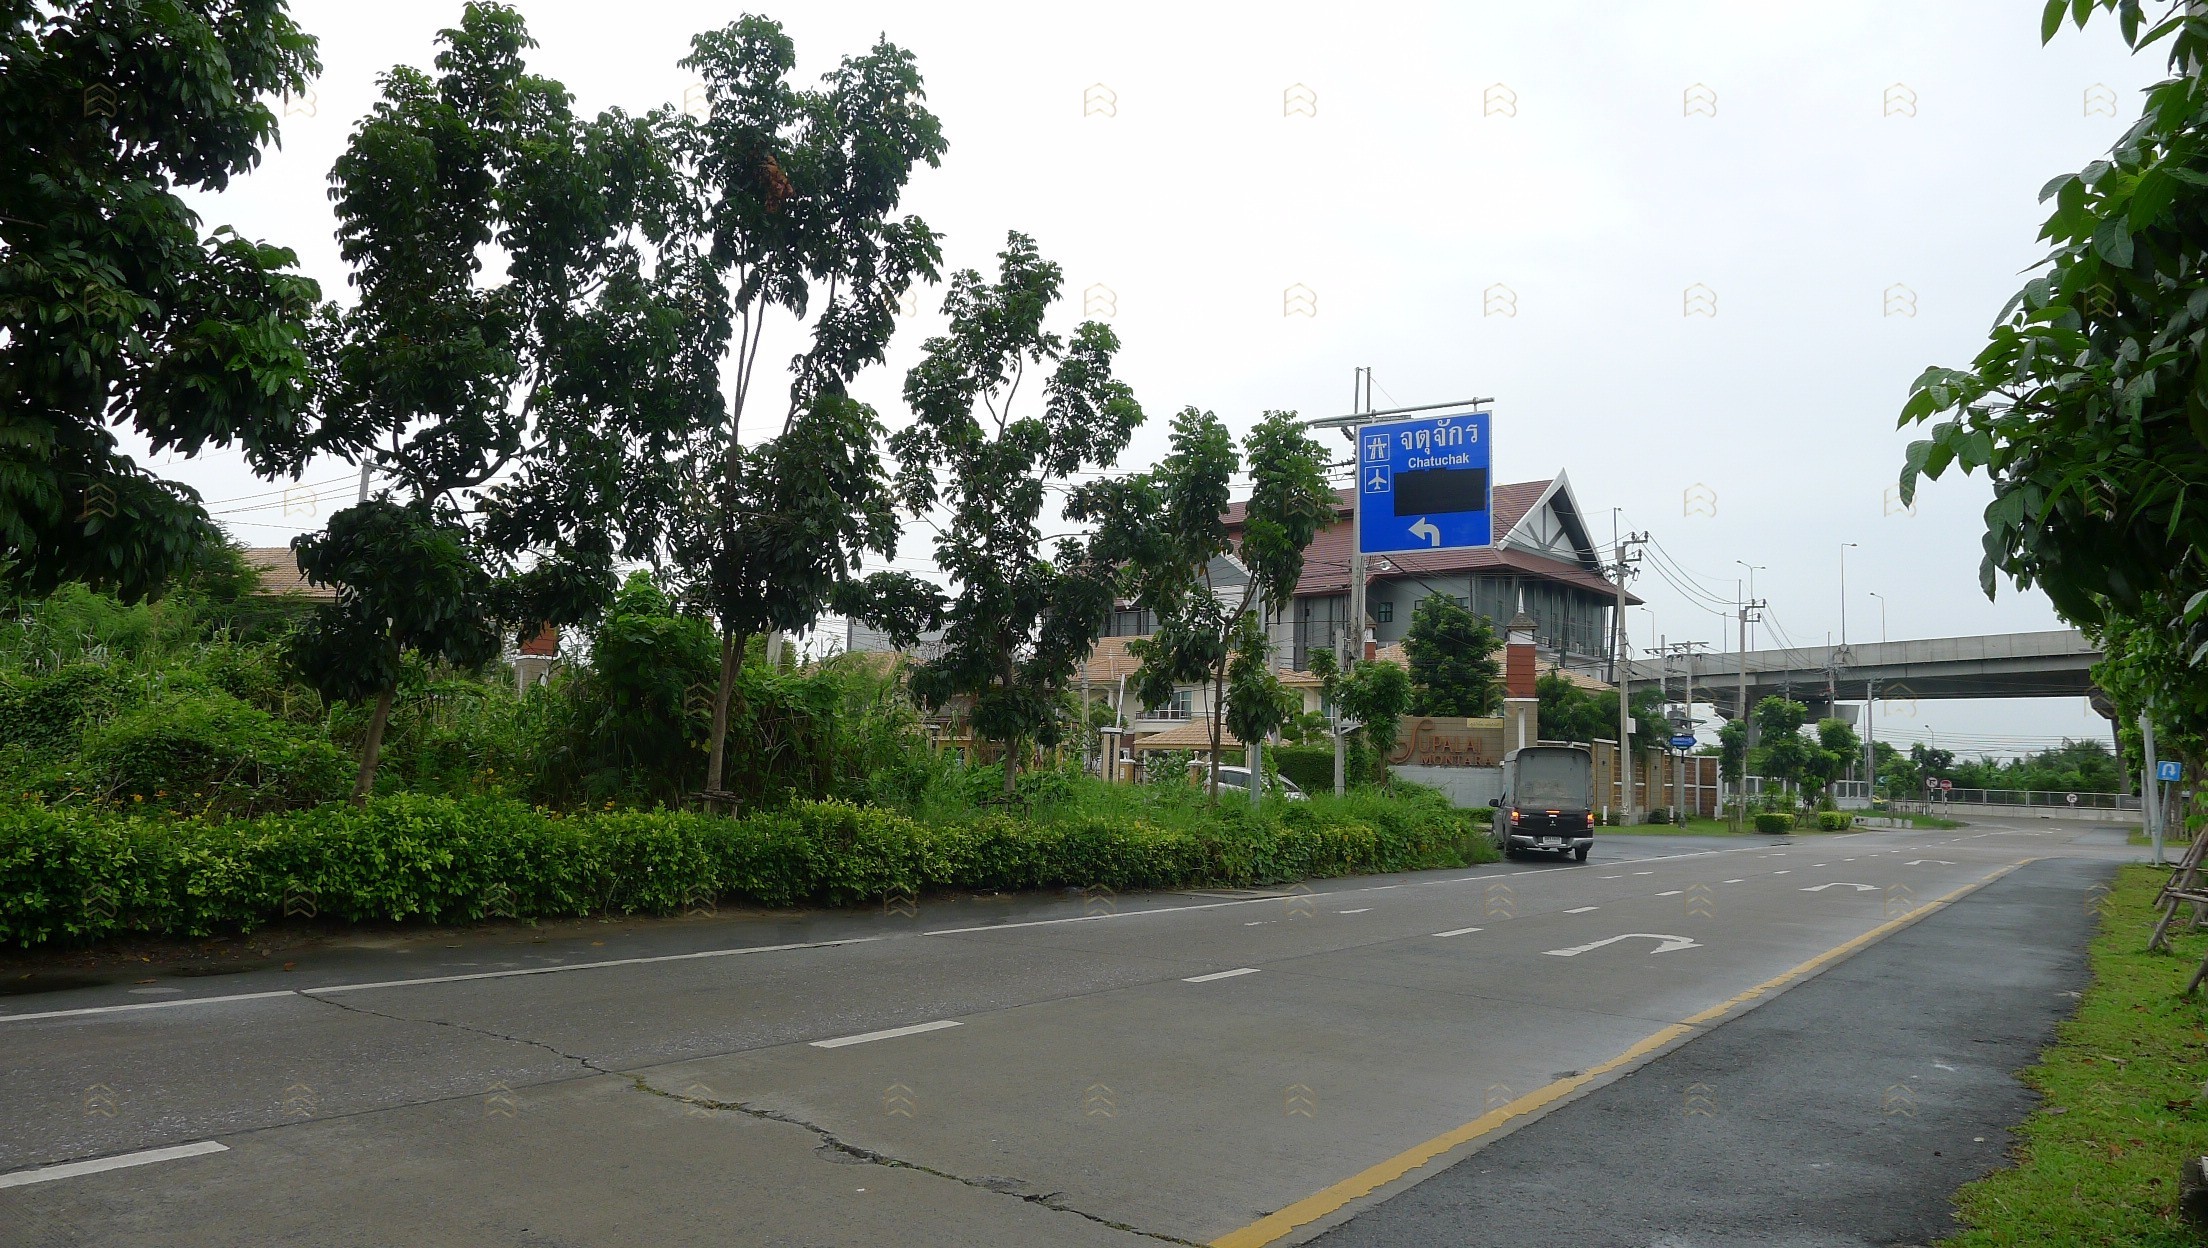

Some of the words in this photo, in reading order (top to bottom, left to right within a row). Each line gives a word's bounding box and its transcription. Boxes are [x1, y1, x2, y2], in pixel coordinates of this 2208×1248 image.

[1400, 418, 1478, 455] จตุจักร
[1408, 452, 1470, 469] Chatuchak
[1420, 754, 1494, 766] MONTARA
